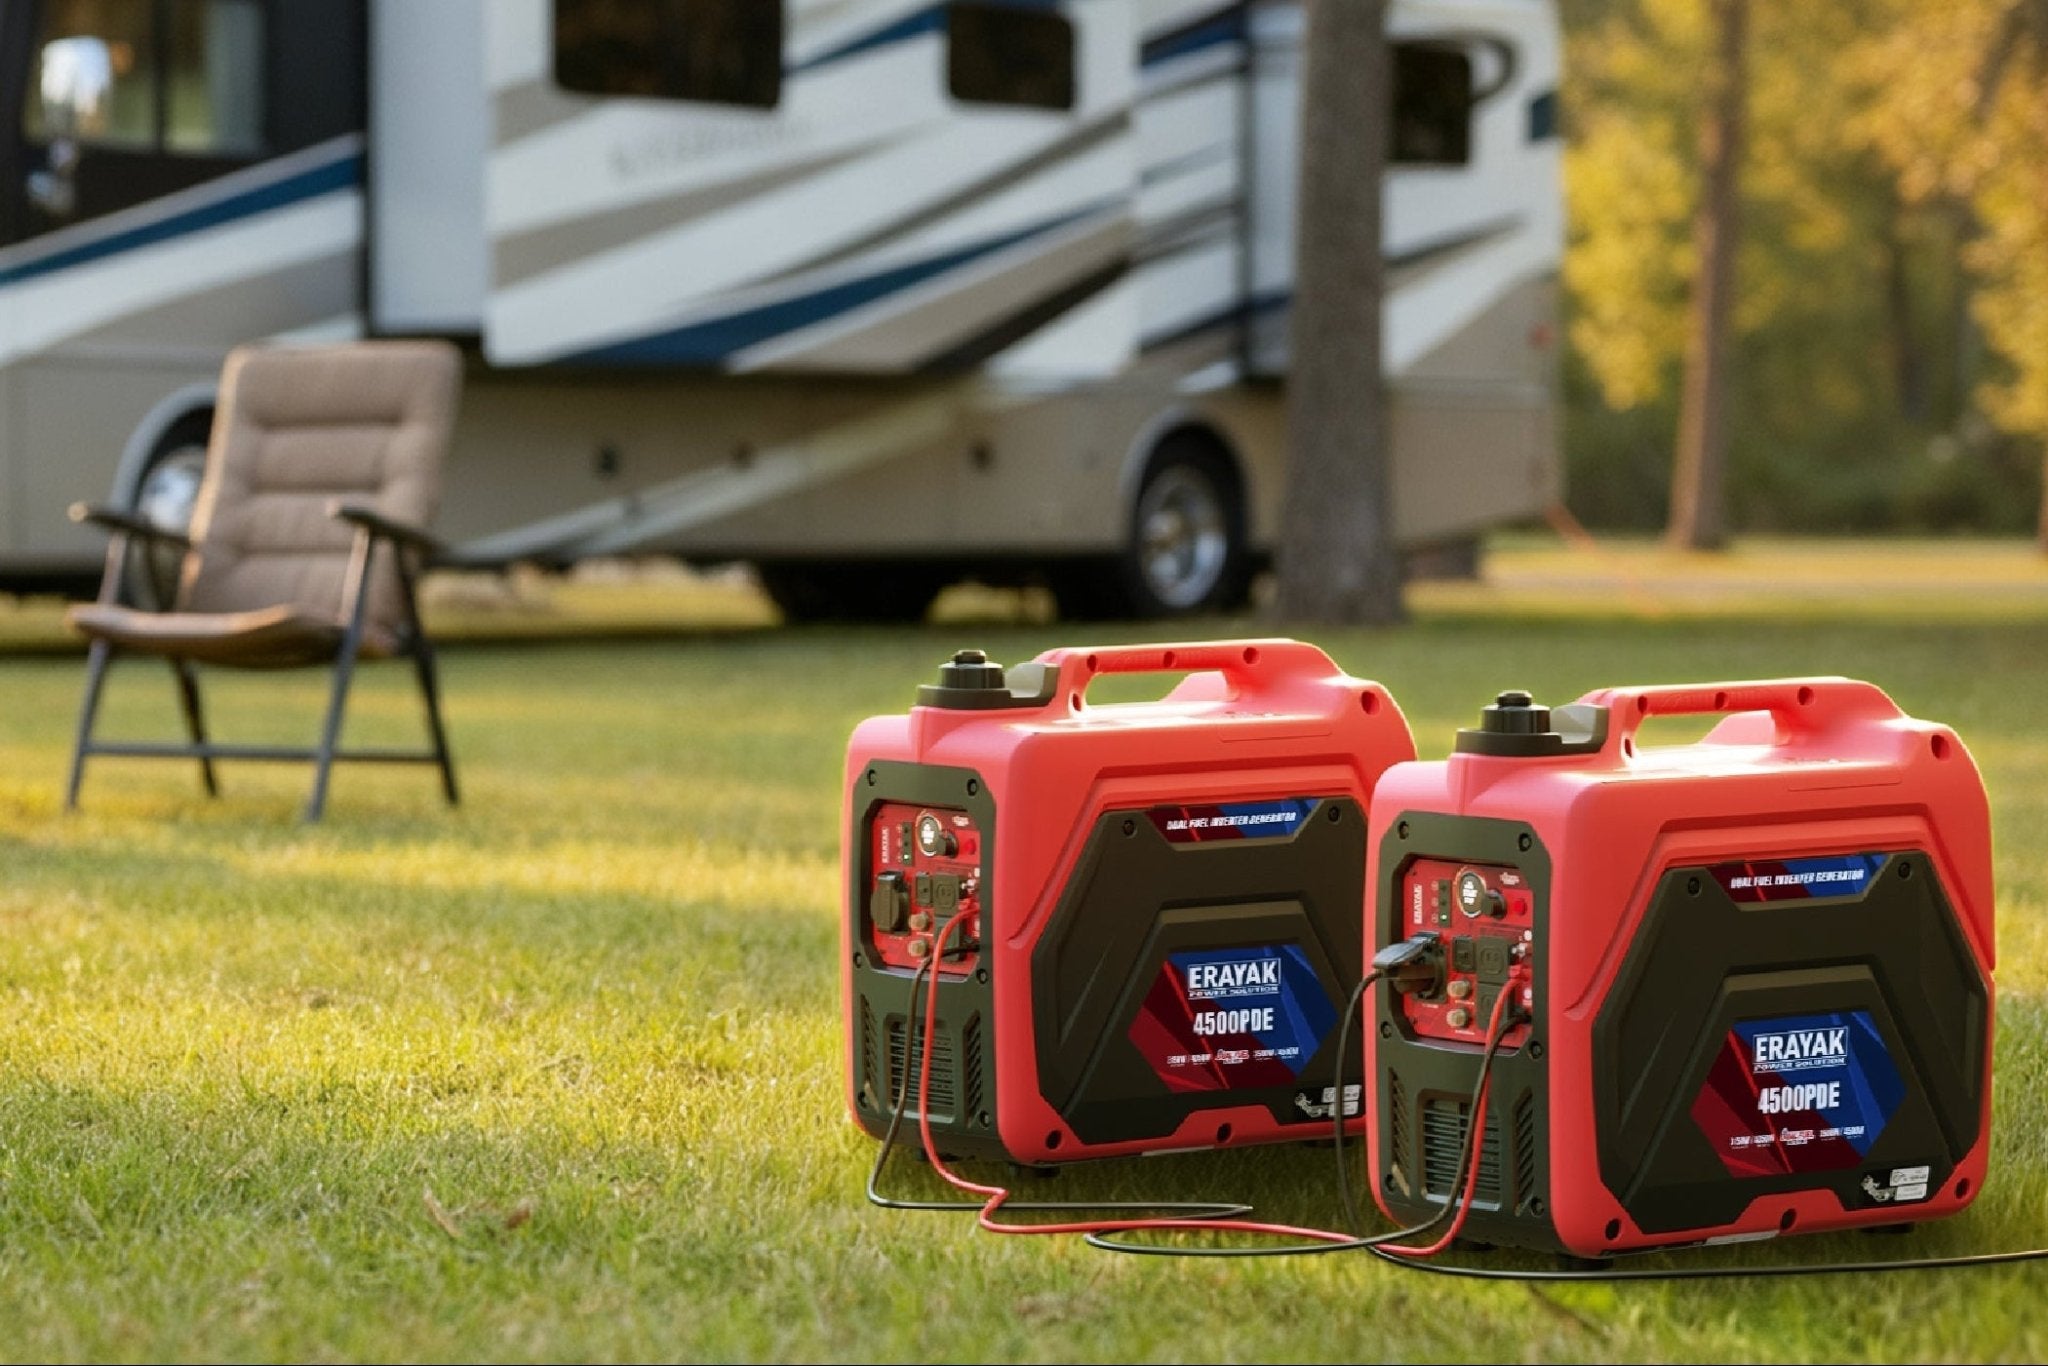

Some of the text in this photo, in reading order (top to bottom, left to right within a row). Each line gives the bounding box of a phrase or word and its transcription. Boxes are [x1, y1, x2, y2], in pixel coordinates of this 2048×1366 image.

[1753, 875, 1773, 886] FUEL
[1189, 961, 1278, 989] ERAYAK
[1193, 1007, 1274, 1036] 4500PDE
[1755, 1029, 1845, 1063] ERAYAK
[1757, 1081, 1840, 1114] 4500PDE
